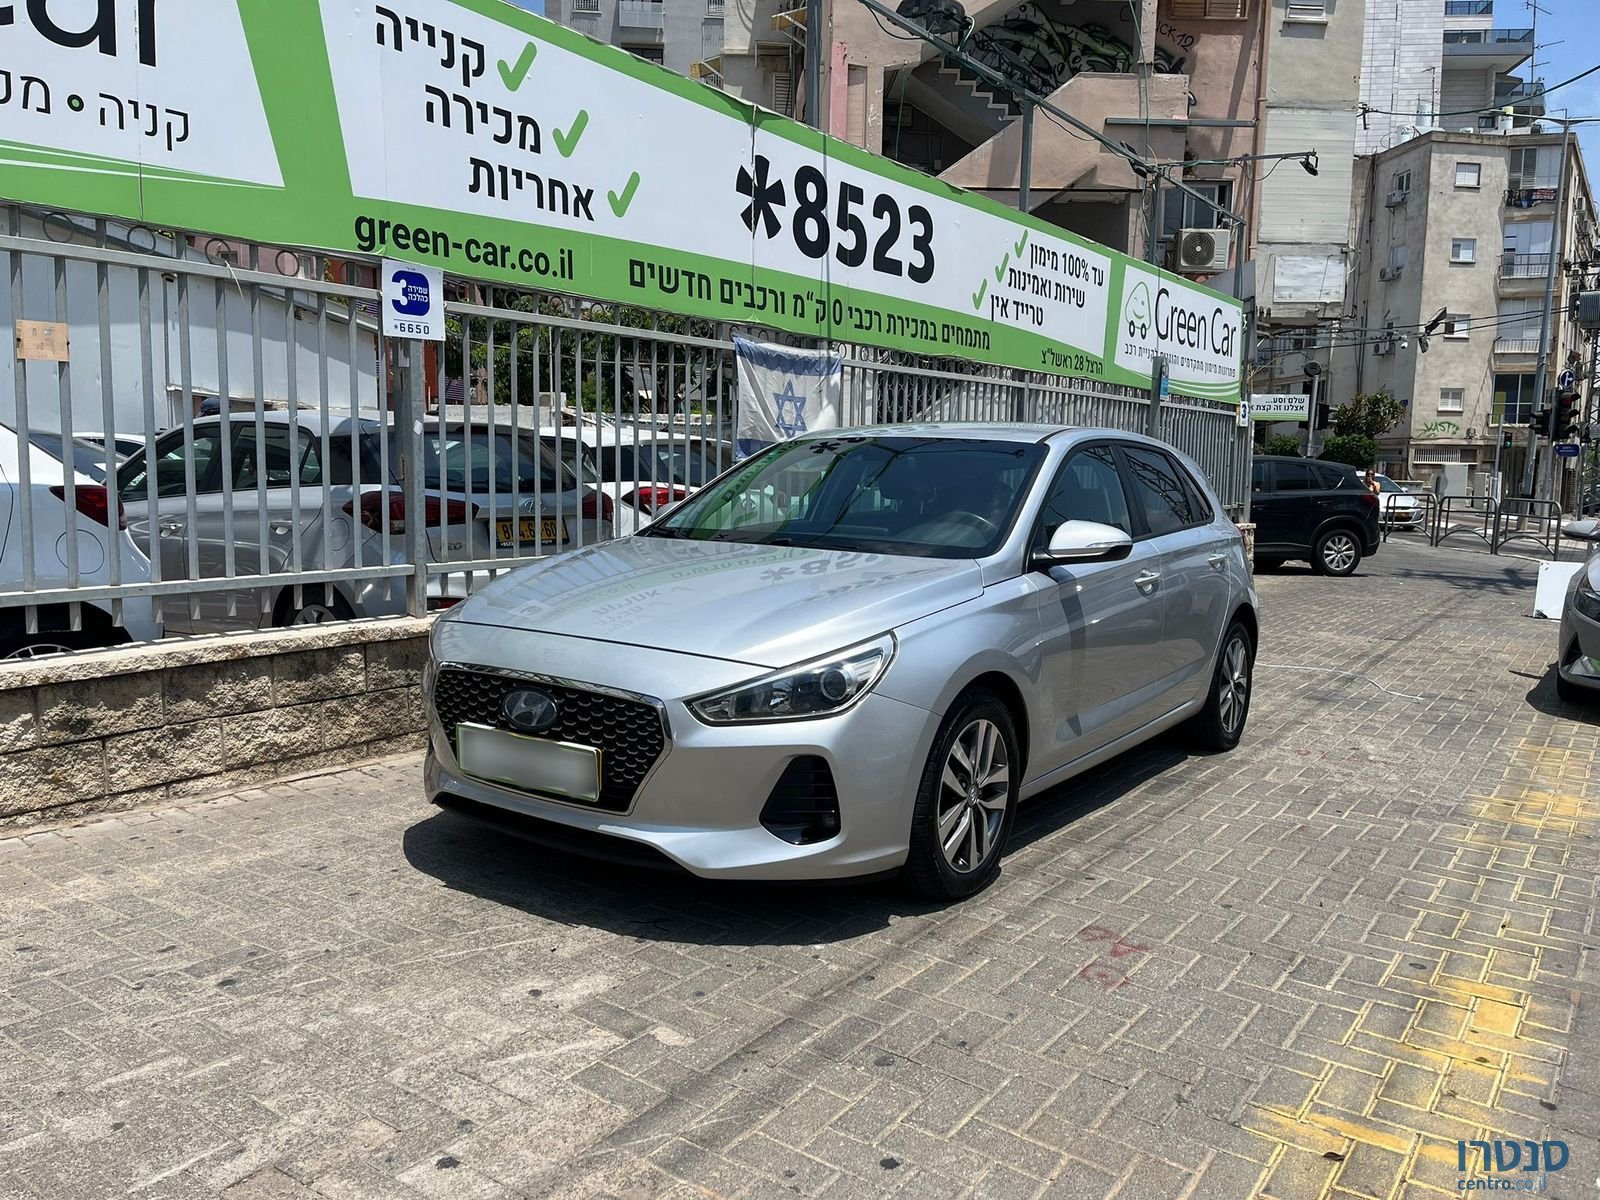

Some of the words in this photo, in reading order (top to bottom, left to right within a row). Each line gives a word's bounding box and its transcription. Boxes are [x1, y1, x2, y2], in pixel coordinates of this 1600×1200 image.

[376, 5, 486, 88] קנייה
[99, 92, 190, 151] קניה
[425, 84, 541, 155] מכירה
[469, 157, 595, 221] אחריות
[355, 215, 574, 280] green-car.co.il
[1030, 243, 1058, 271] מימון
[629, 259, 711, 301] חדשים
[1062, 253, 1089, 282] 100%
[1092, 266, 1104, 287] עד
[407, 285, 428, 294] שמירה
[1008, 267, 1051, 299] ואמינות
[1054, 282, 1085, 308] שירות
[408, 293, 428, 303] כהלכה
[721, 279, 785, 315] ורכבים
[991, 295, 1009, 321] אין
[833, 299, 843, 326] 0
[848, 307, 884, 335] רכבי
[1013, 300, 1044, 326] טרייד
[1155, 288, 1207, 351] Green
[1211, 307, 1237, 358] Car
[886, 313, 938, 342] במכירת
[942, 325, 990, 351] מתמחים
[1074, 354, 1084, 372] 28
[1125, 343, 1137, 356] רכב
[1086, 356, 1103, 375] הרצל
[1256, 404, 1271, 412] קצת
[1288, 396, 1305, 404] שלם
